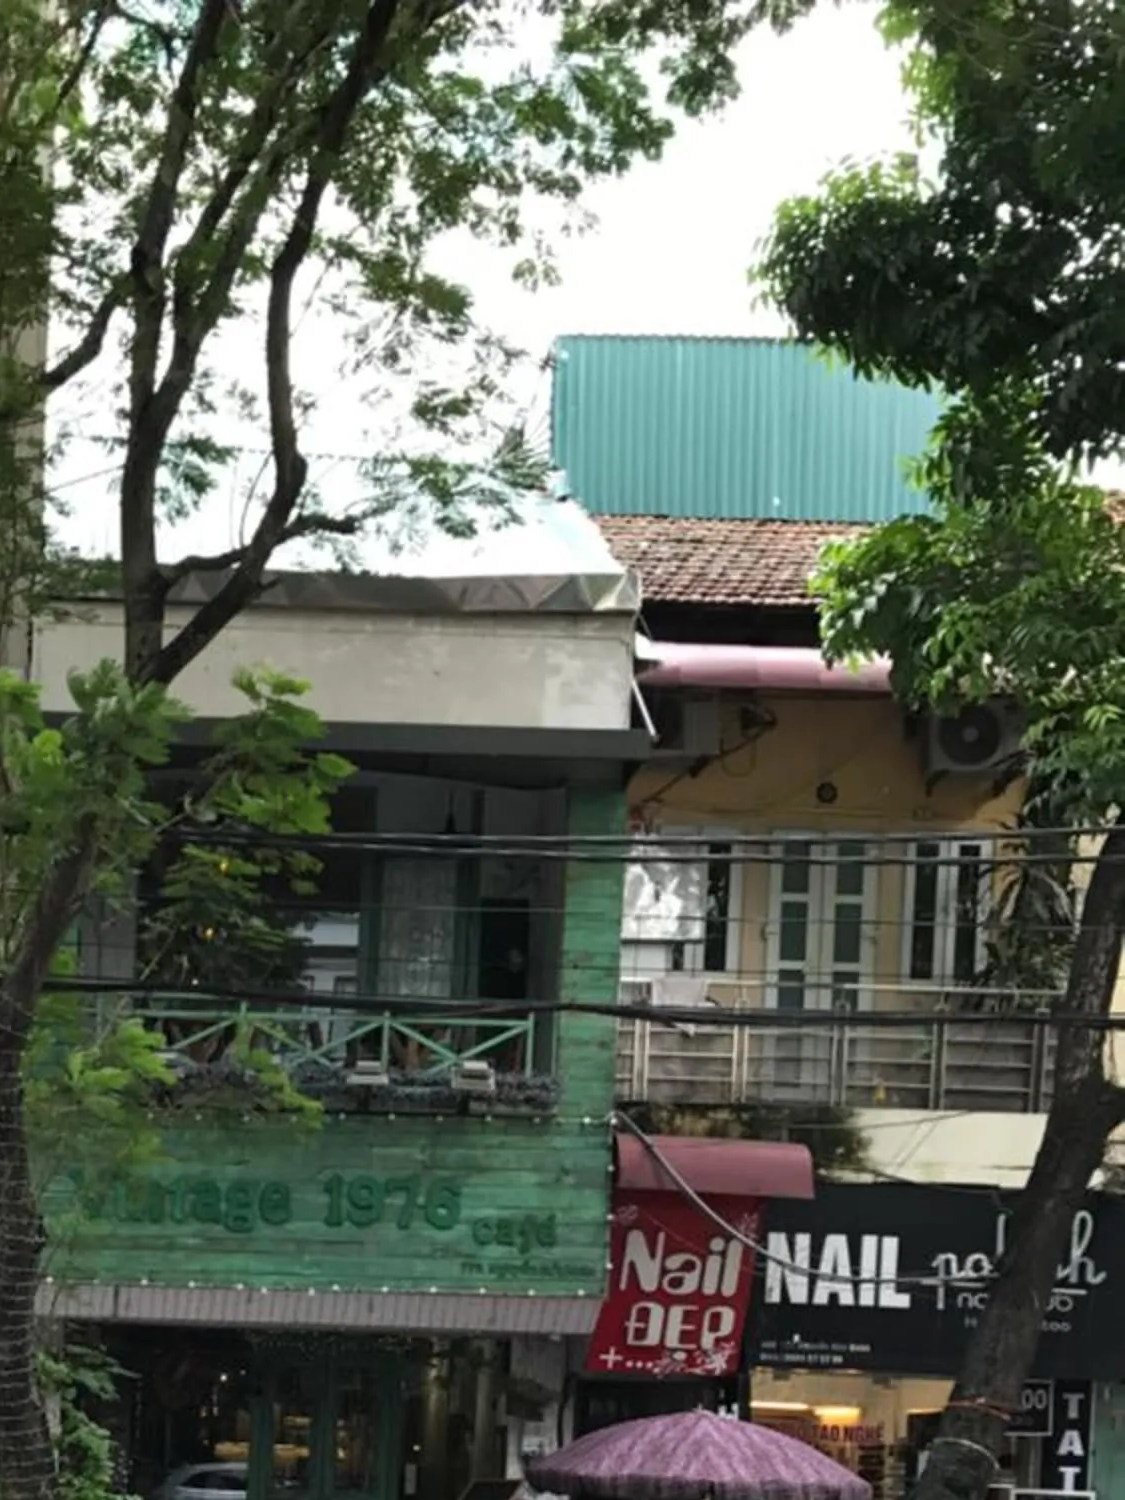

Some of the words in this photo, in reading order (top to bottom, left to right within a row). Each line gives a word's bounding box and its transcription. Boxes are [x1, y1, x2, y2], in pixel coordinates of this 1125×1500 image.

[323, 1173, 461, 1232] 1976
[618, 1228, 744, 1298] Nail
[764, 1231, 911, 1310] NAIL
[931, 1210, 1108, 1311] polh
